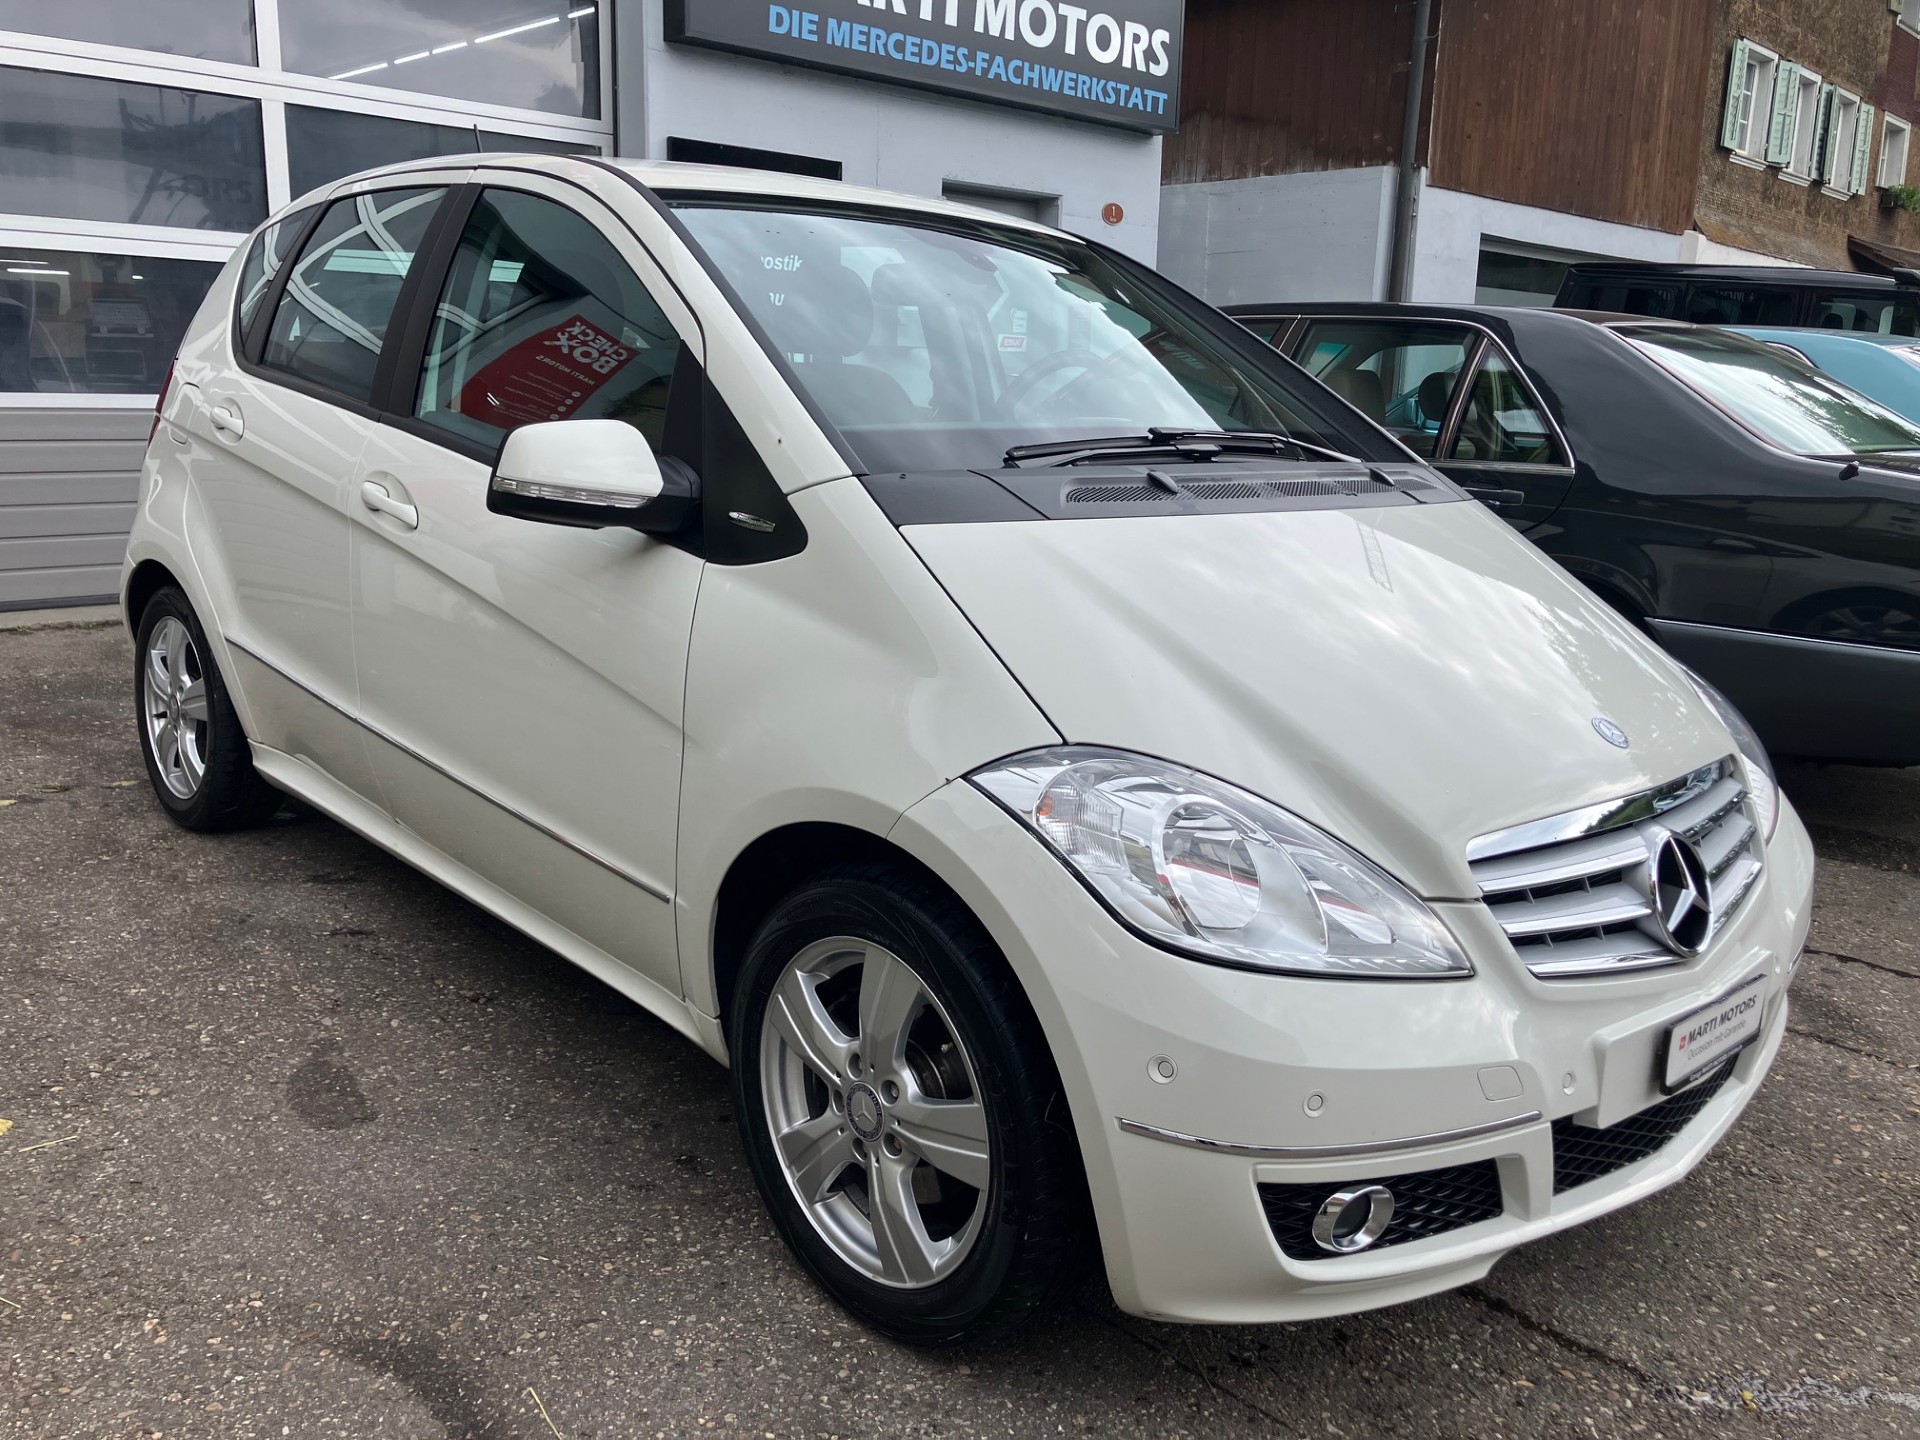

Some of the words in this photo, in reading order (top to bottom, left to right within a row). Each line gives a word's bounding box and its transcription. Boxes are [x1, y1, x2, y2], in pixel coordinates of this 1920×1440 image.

[768, 5, 818, 42] DIE
[826, 17, 1168, 115] MERCEDES-FACHWERKSTATT
[973, 0, 1170, 77] MOTORS
[761, 255, 803, 271] ostik
[1688, 1016, 1718, 1043] MARTI
[1720, 995, 1757, 1026] MOTORS
